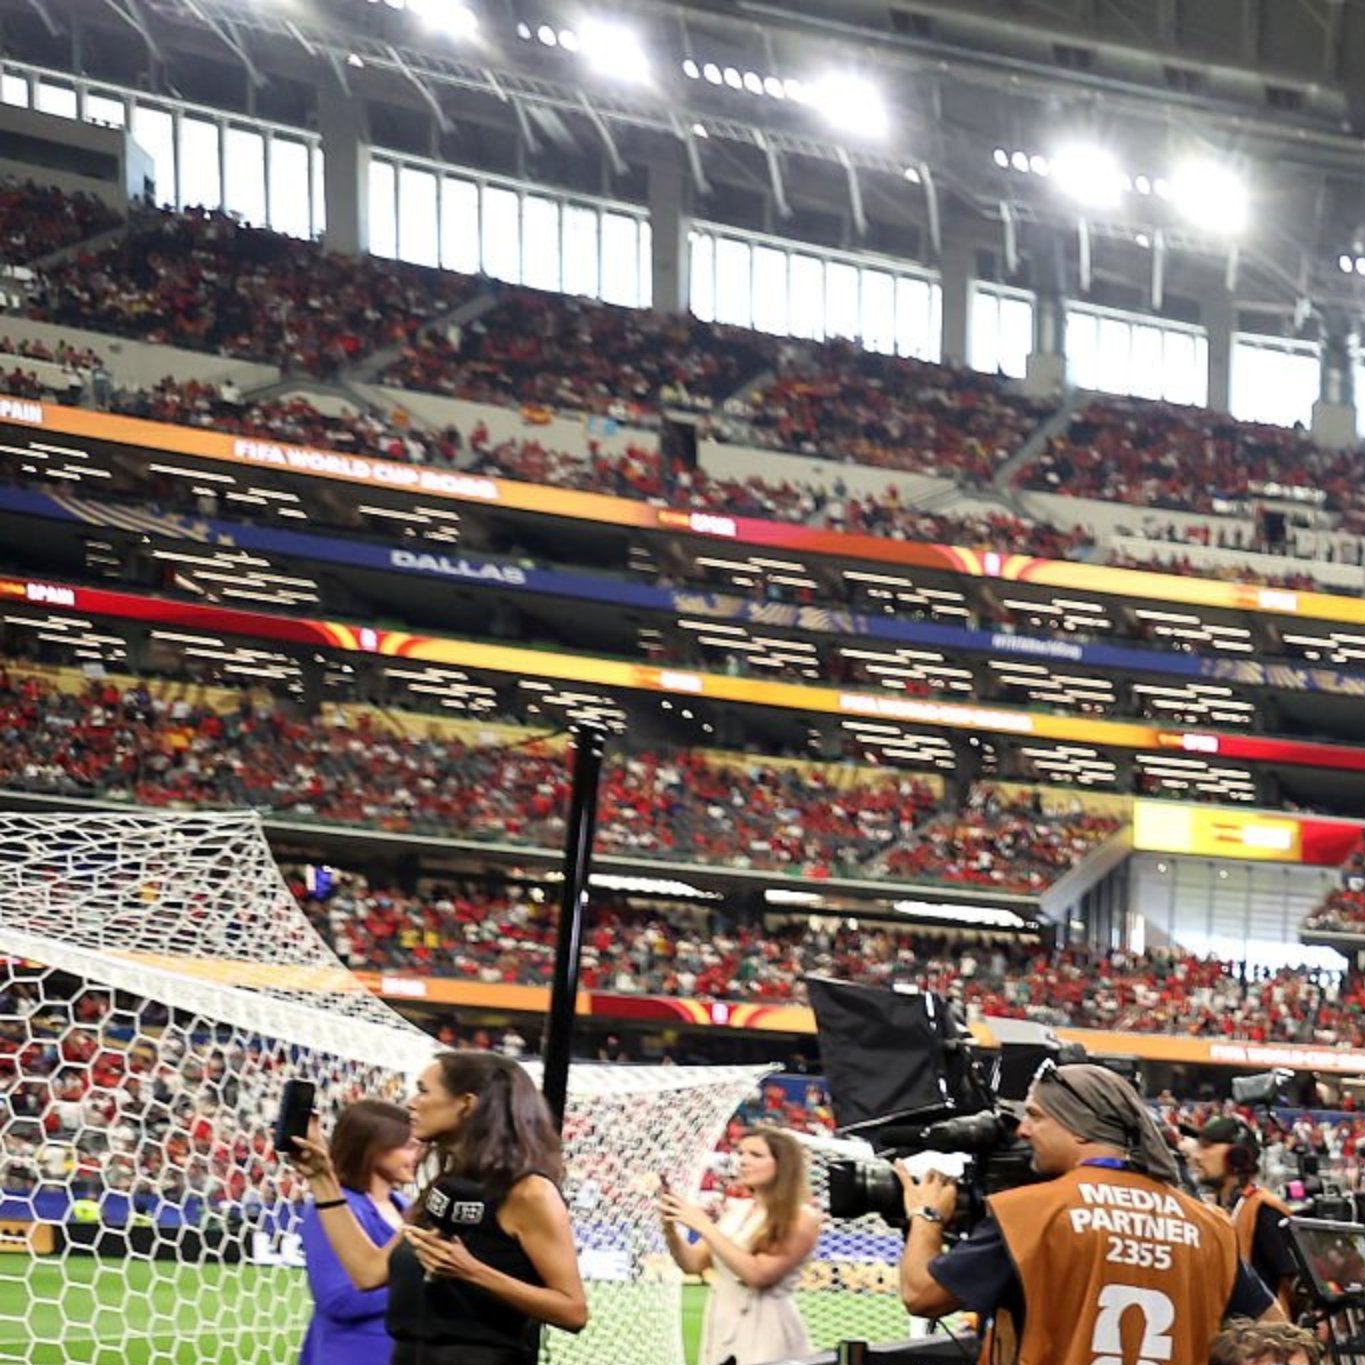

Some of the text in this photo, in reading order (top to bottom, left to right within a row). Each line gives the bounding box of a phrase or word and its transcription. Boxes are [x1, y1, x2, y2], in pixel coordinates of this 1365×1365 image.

[0, 399, 43, 424] PAIN
[390, 549, 526, 586] DALLAS
[1078, 1183, 1185, 1218] MEDIA
[1069, 1207, 1201, 1249] PARTNER
[1106, 1236, 1172, 1270] 2355
